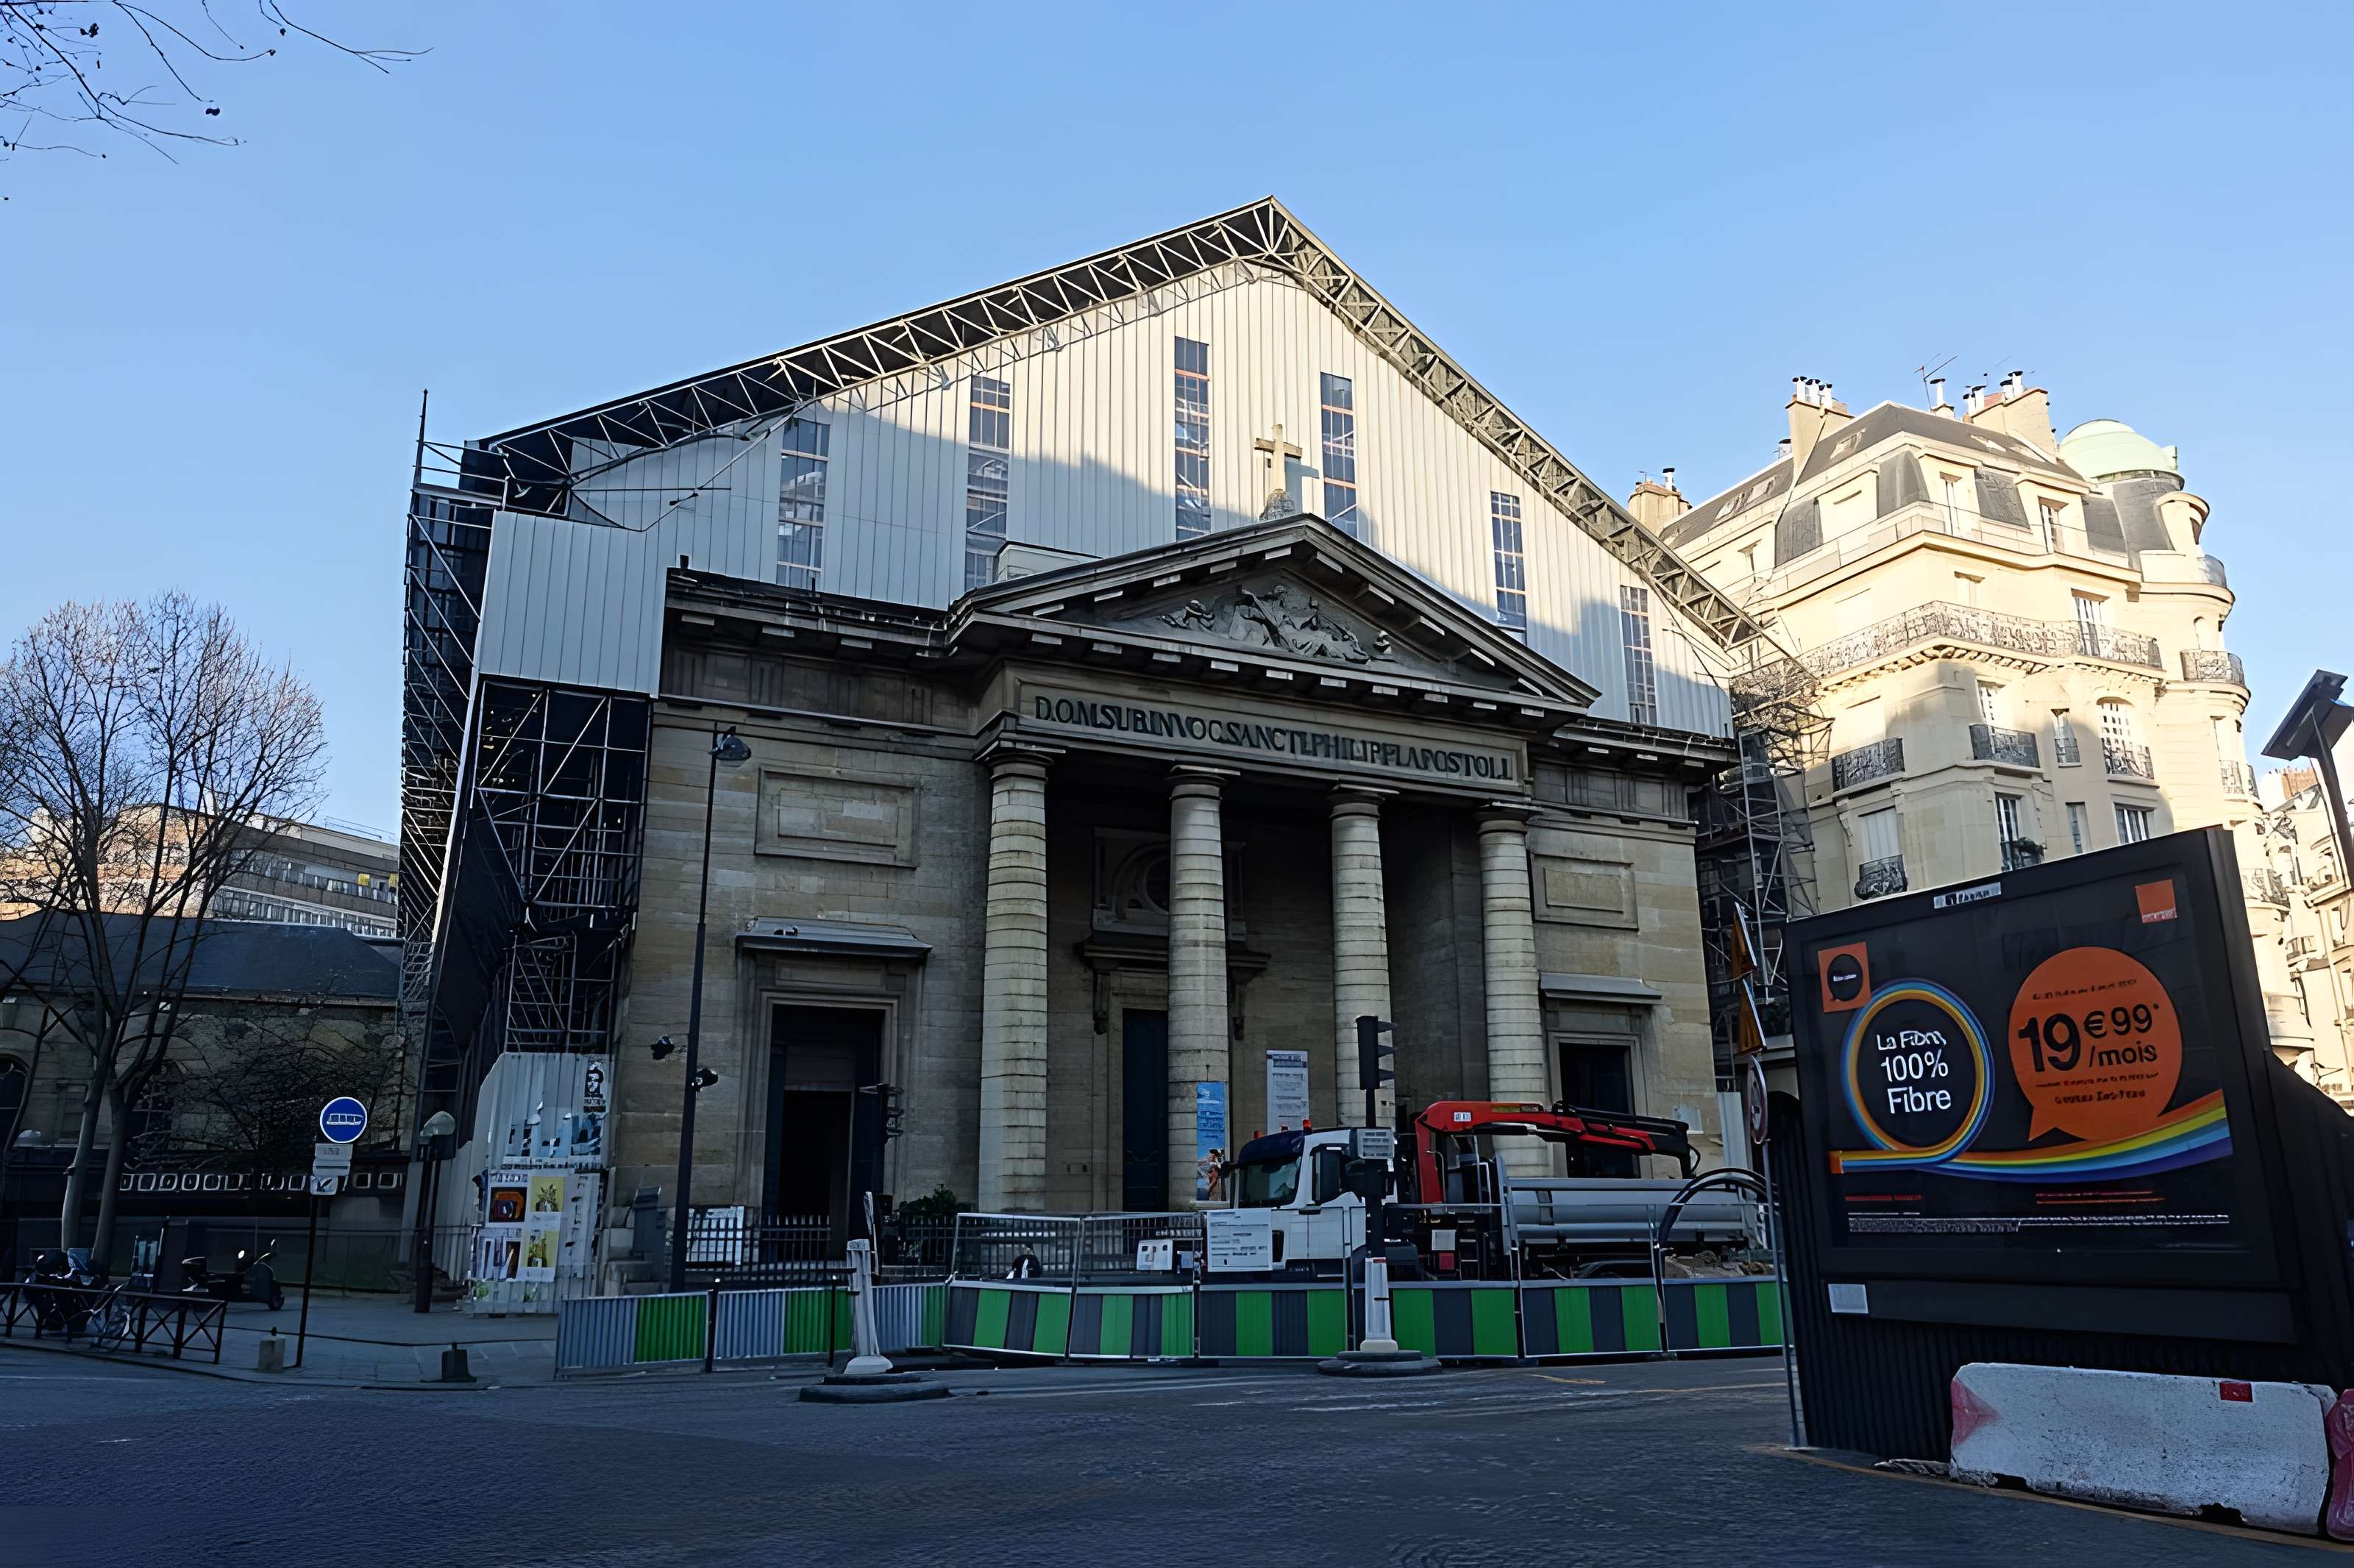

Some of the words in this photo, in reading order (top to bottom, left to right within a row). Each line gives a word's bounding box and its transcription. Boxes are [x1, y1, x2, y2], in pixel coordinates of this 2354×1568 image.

[1876, 1034, 1897, 1050] La
[1880, 1048, 1949, 1082] 100%
[1887, 1086, 1952, 1113] Fibre
